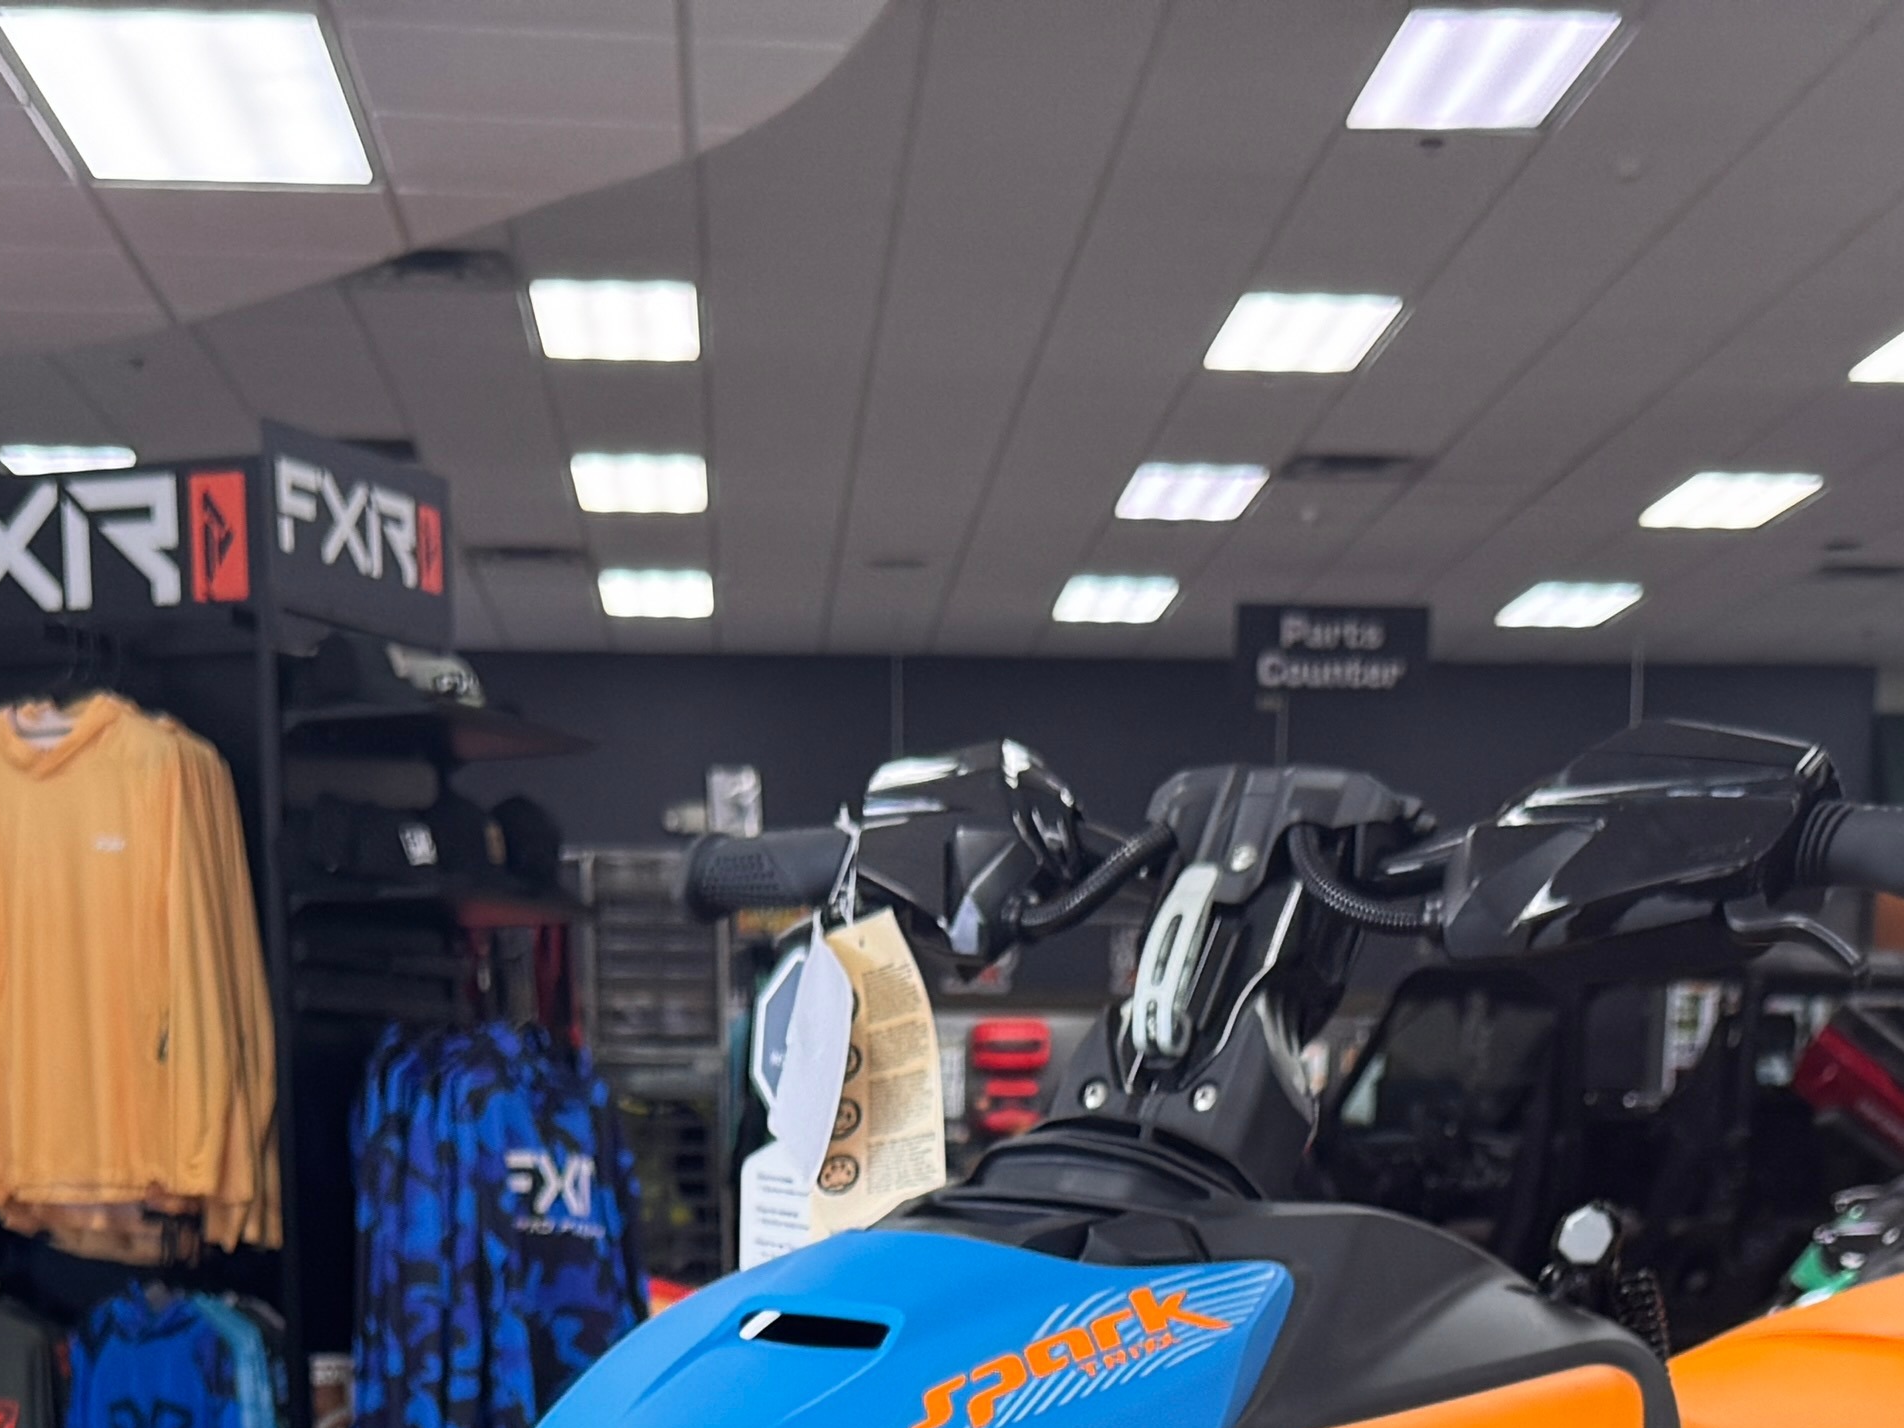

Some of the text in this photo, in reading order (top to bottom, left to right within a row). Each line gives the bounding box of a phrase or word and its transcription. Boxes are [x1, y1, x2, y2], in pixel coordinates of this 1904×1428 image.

[274, 455, 418, 590] FXR
[1279, 614, 1386, 650] Parts
[1256, 652, 1409, 689] Counter
